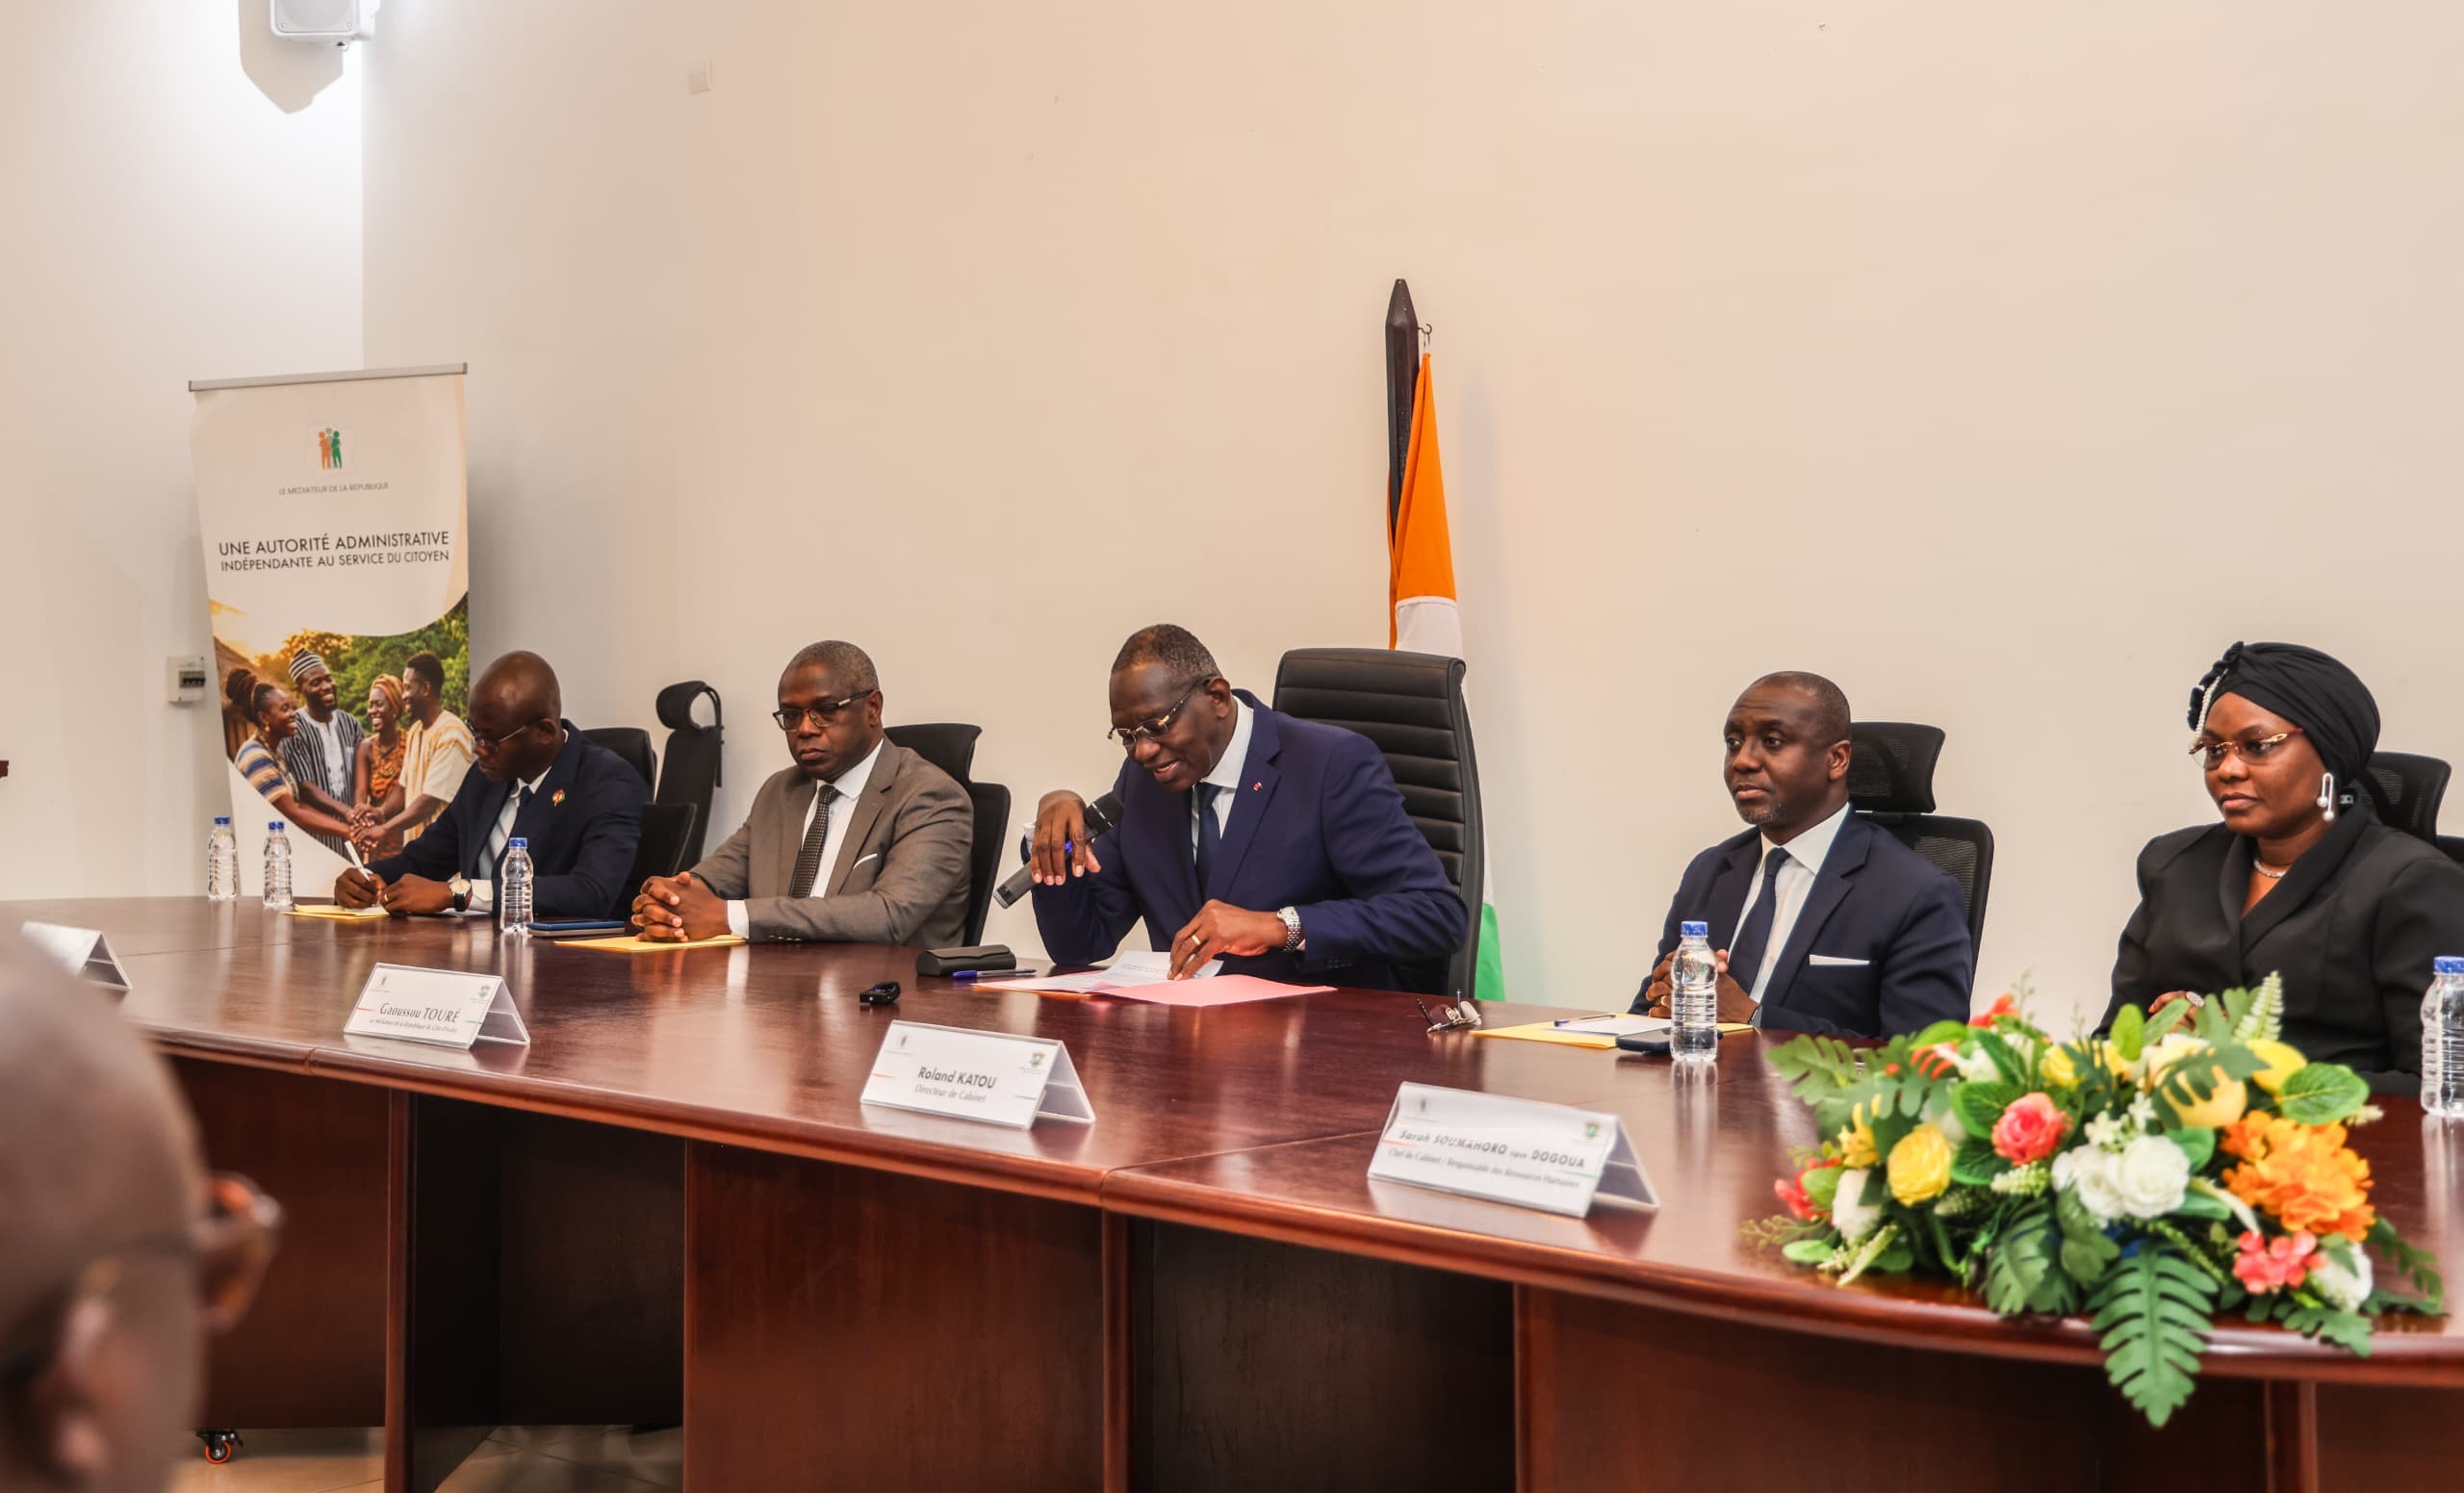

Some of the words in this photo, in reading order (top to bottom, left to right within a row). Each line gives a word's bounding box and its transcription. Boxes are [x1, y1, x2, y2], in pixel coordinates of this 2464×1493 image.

[218, 542, 250, 555] UNE
[255, 533, 330, 554] AUTORITÉ
[335, 531, 449, 550] ADMINISTRATIVE
[220, 555, 313, 572] INDÉPENDANTE
[317, 555, 335, 567] AU
[339, 553, 384, 566] SERVICE
[387, 553, 401, 564] DU
[403, 551, 449, 563] CITOYEN
[379, 1002, 421, 1018] Gaoussou
[423, 1007, 462, 1023] TOURÉ
[917, 1067, 957, 1084] Roland
[957, 1072, 997, 1090] KATOU
[914, 1083, 947, 1098] Directeur
[948, 1089, 958, 1099] de
[958, 1089, 987, 1103] Cabinet
[1399, 1129, 1430, 1144] Sarah
[1531, 1149, 1585, 1170] DOGOUA
